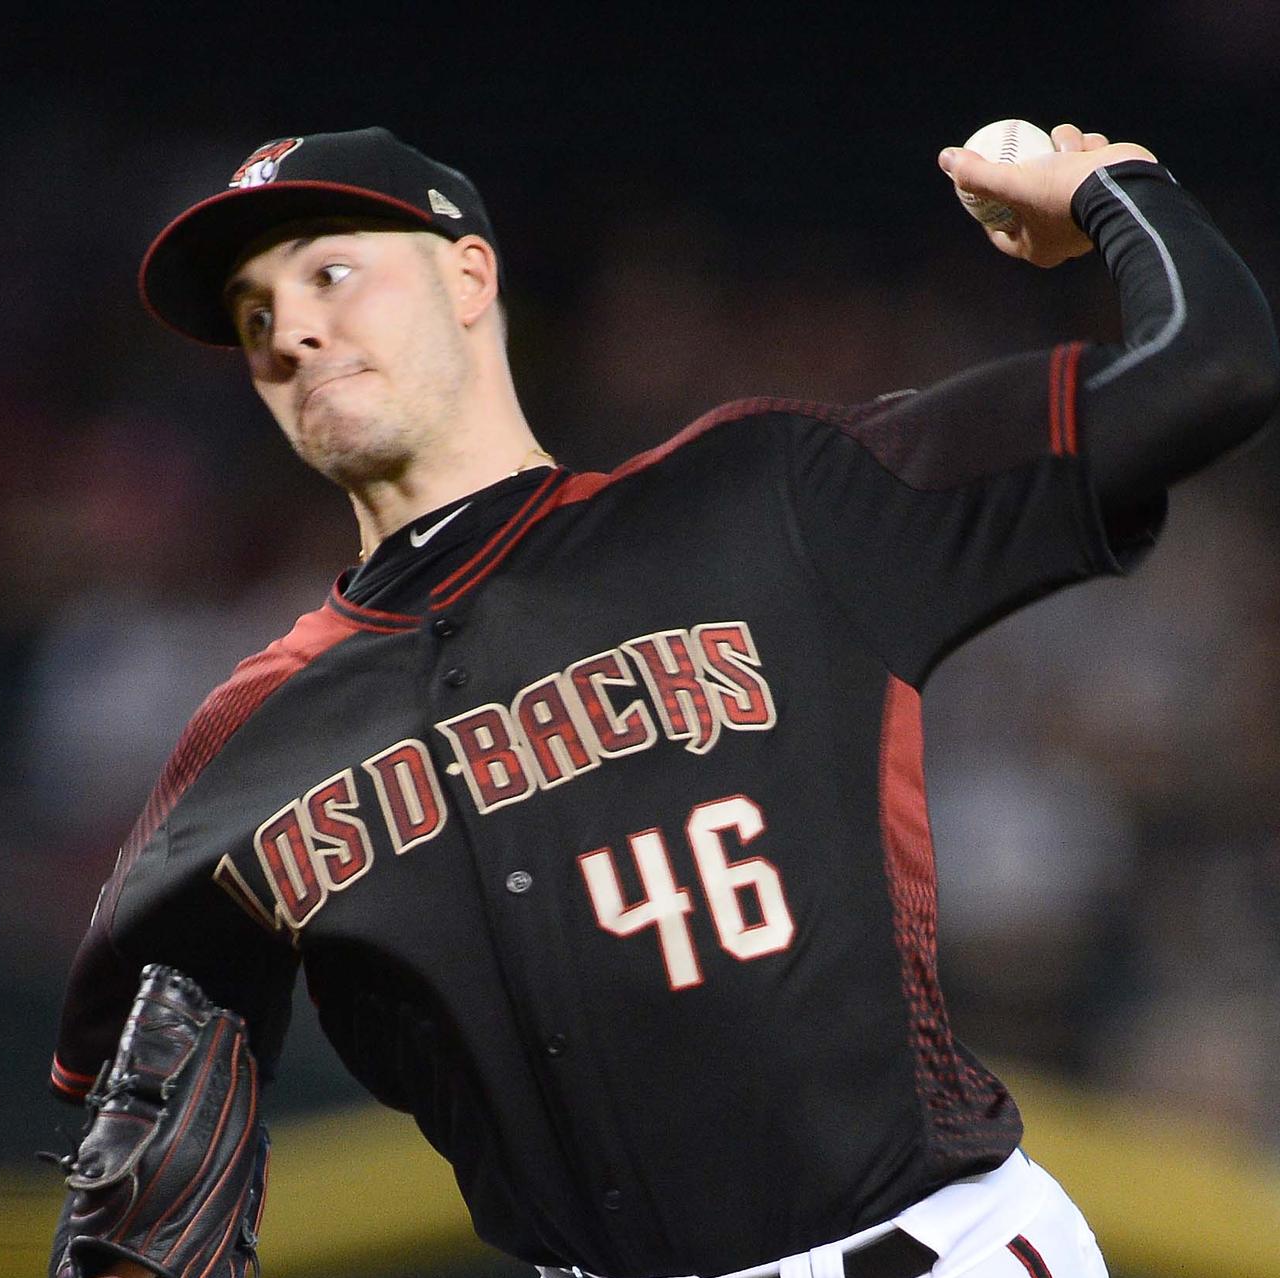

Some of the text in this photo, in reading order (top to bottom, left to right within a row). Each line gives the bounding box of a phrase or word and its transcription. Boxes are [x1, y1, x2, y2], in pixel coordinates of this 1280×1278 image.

[212, 621, 777, 936] LOS D-BACKS
[577, 793, 797, 991] 46
